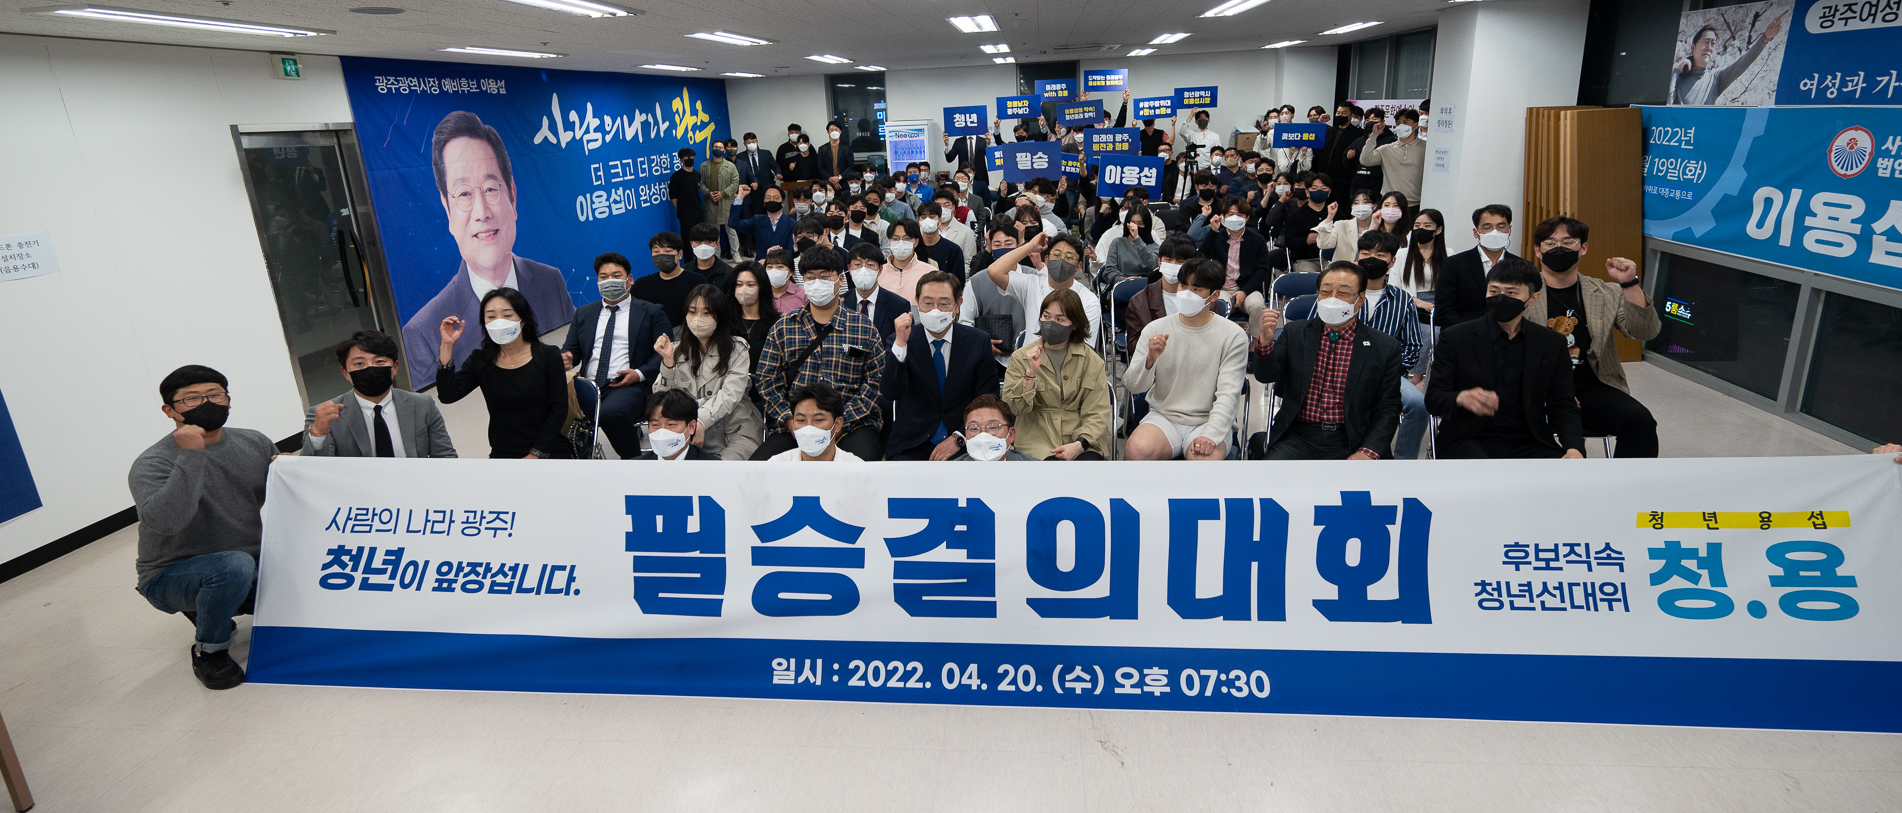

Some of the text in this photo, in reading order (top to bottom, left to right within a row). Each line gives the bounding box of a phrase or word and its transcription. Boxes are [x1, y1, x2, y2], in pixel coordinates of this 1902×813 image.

[374, 75, 507, 95] 광주광역시장 예비후보 이용섭
[1799, 70, 1902, 99] 여성과 가
[953, 113, 978, 128] 청년
[1092, 133, 1132, 143] 미래의 광주,
[1092, 143, 1114, 151] 비전과
[1281, 132, 1316, 141] 꽃보다 용섭
[1649, 126, 1696, 149] 2022년
[590, 162, 605, 186] 더
[608, 160, 635, 183] 크고
[637, 156, 649, 178] 더
[650, 153, 671, 176] 강한
[1015, 151, 1049, 170] 필승
[1653, 157, 1707, 184] 19일(화)
[1104, 164, 1158, 187] 이용섭
[576, 186, 637, 222] 이용섭이
[1659, 187, 1693, 201] 대중교통으로
[17, 240, 40, 249] 충전기
[0, 262, 40, 274] (음용수대)
[1, 252, 32, 262] 설치장소
[325, 507, 516, 538] 사람의 나라 광주!
[625, 490, 1433, 625] 필승결의대회
[1501, 541, 1625, 573] 후보직속
[318, 544, 581, 596] 청년이 앞장섭니다.
[1646, 540, 1860, 621] 청.용
[1473, 579, 1630, 613] 청년선대위
[771, 658, 823, 686] 일시
[848, 660, 931, 689] 2022.
[941, 662, 988, 691] 04.
[997, 663, 1043, 693] 20.
[1053, 664, 1105, 695] (수)
[1114, 666, 1171, 696] 오후
[1179, 668, 1271, 699] 07:30
